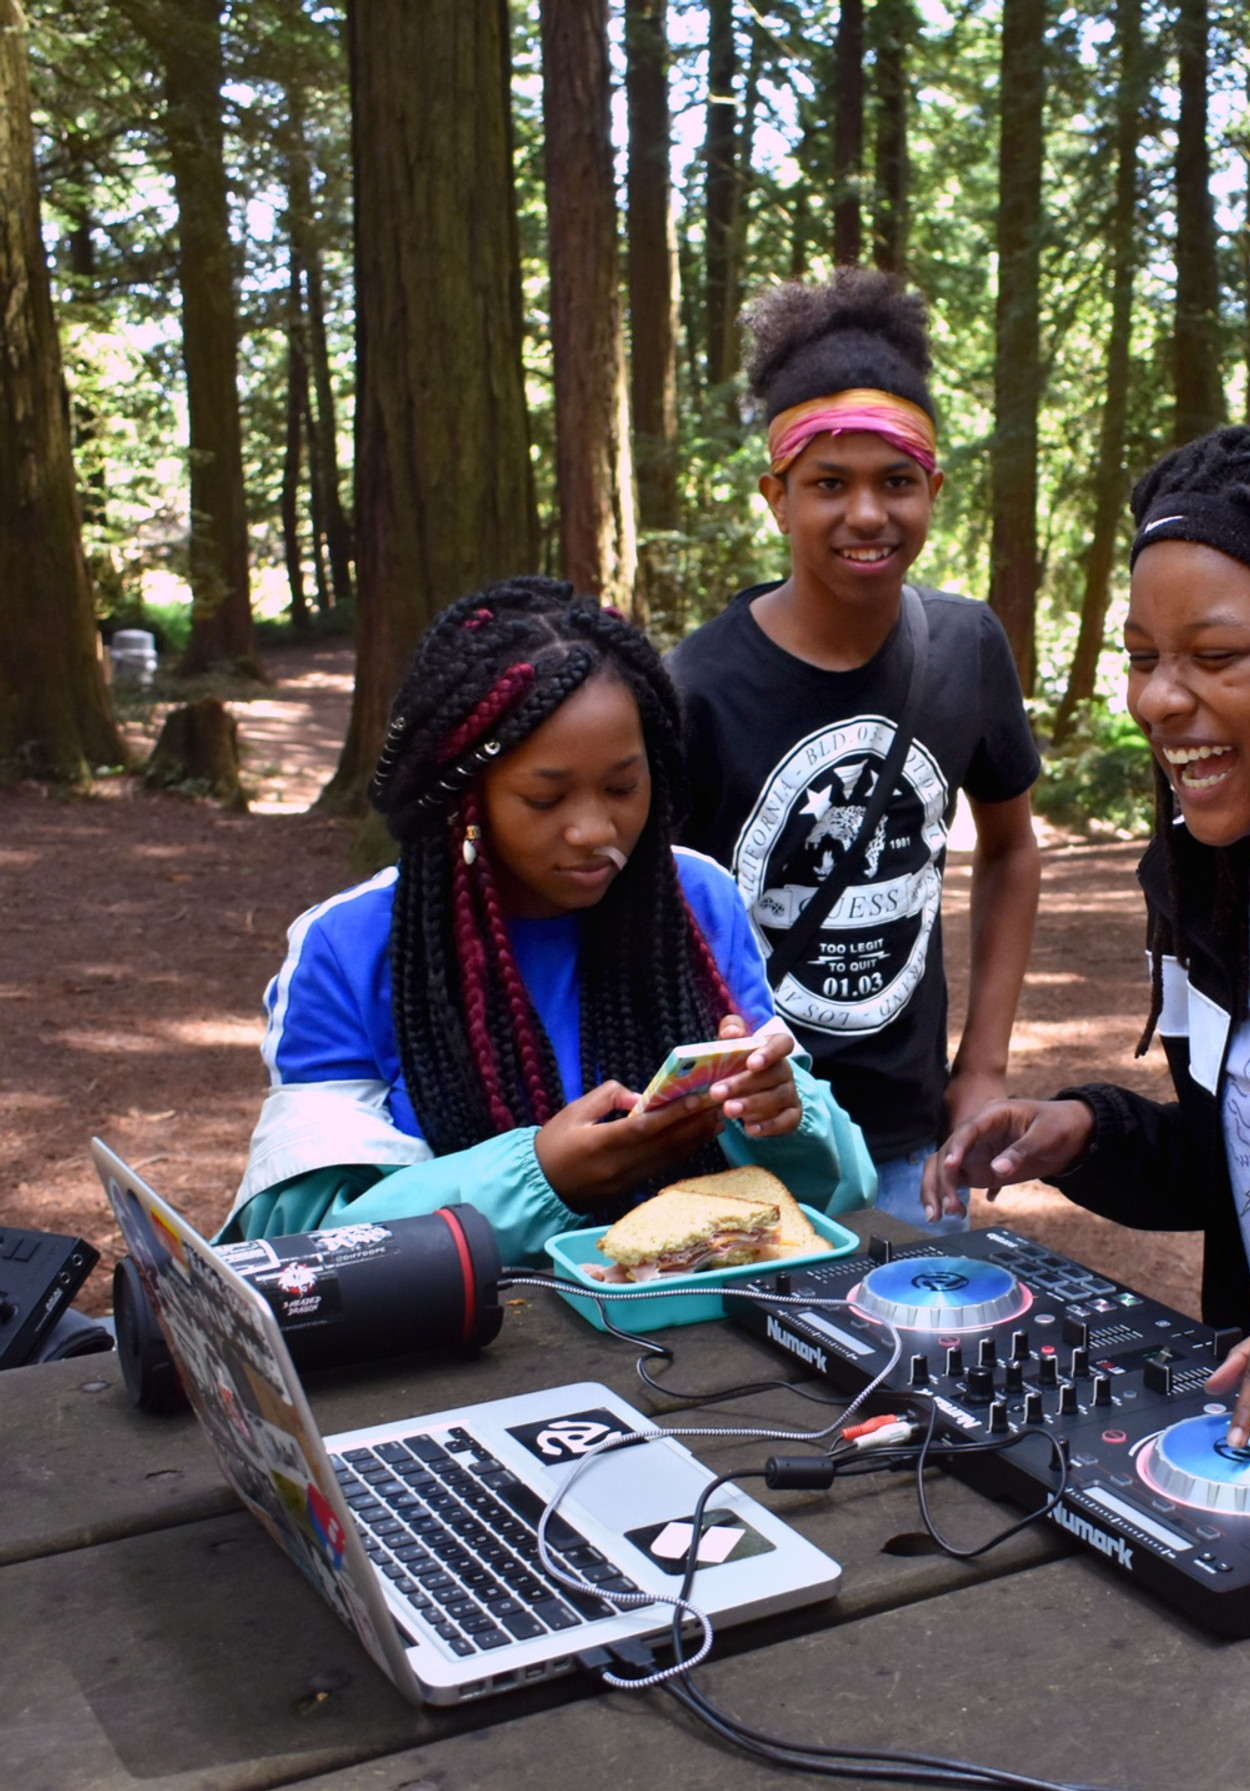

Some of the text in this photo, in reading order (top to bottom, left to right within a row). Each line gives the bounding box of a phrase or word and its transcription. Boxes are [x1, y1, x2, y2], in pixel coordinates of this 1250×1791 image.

[819, 937, 884, 954] TOO LEGIT
[829, 958, 878, 972] TO QUIT
[822, 971, 884, 997] 01.03
[767, 1314, 828, 1374] Numark
[1047, 1492, 1134, 1571] Numark
